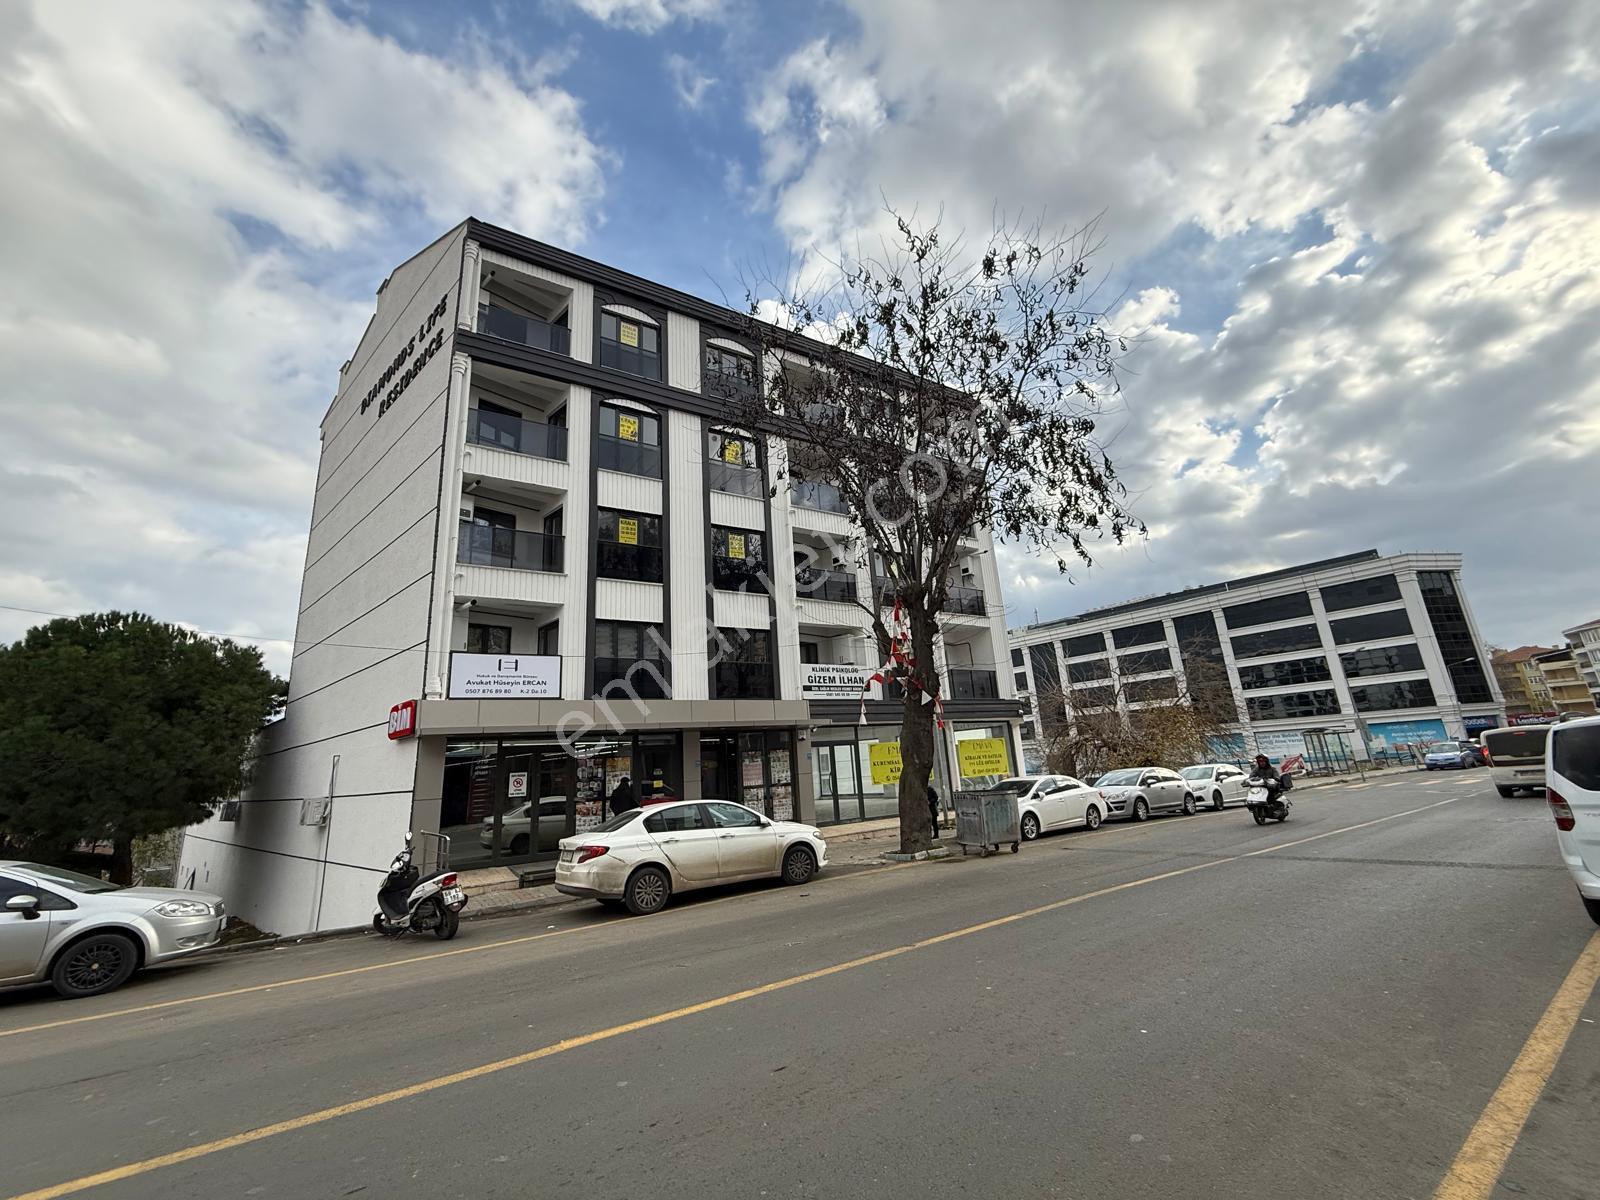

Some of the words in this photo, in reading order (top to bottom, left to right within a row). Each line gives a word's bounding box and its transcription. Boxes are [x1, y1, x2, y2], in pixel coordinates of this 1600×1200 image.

[419, 293, 449, 342] LIFE
[378, 327, 444, 418] RESIDENCE
[808, 674, 836, 684] GİZEM
[839, 674, 865, 685] İLHAN
[388, 704, 412, 734] BİM
